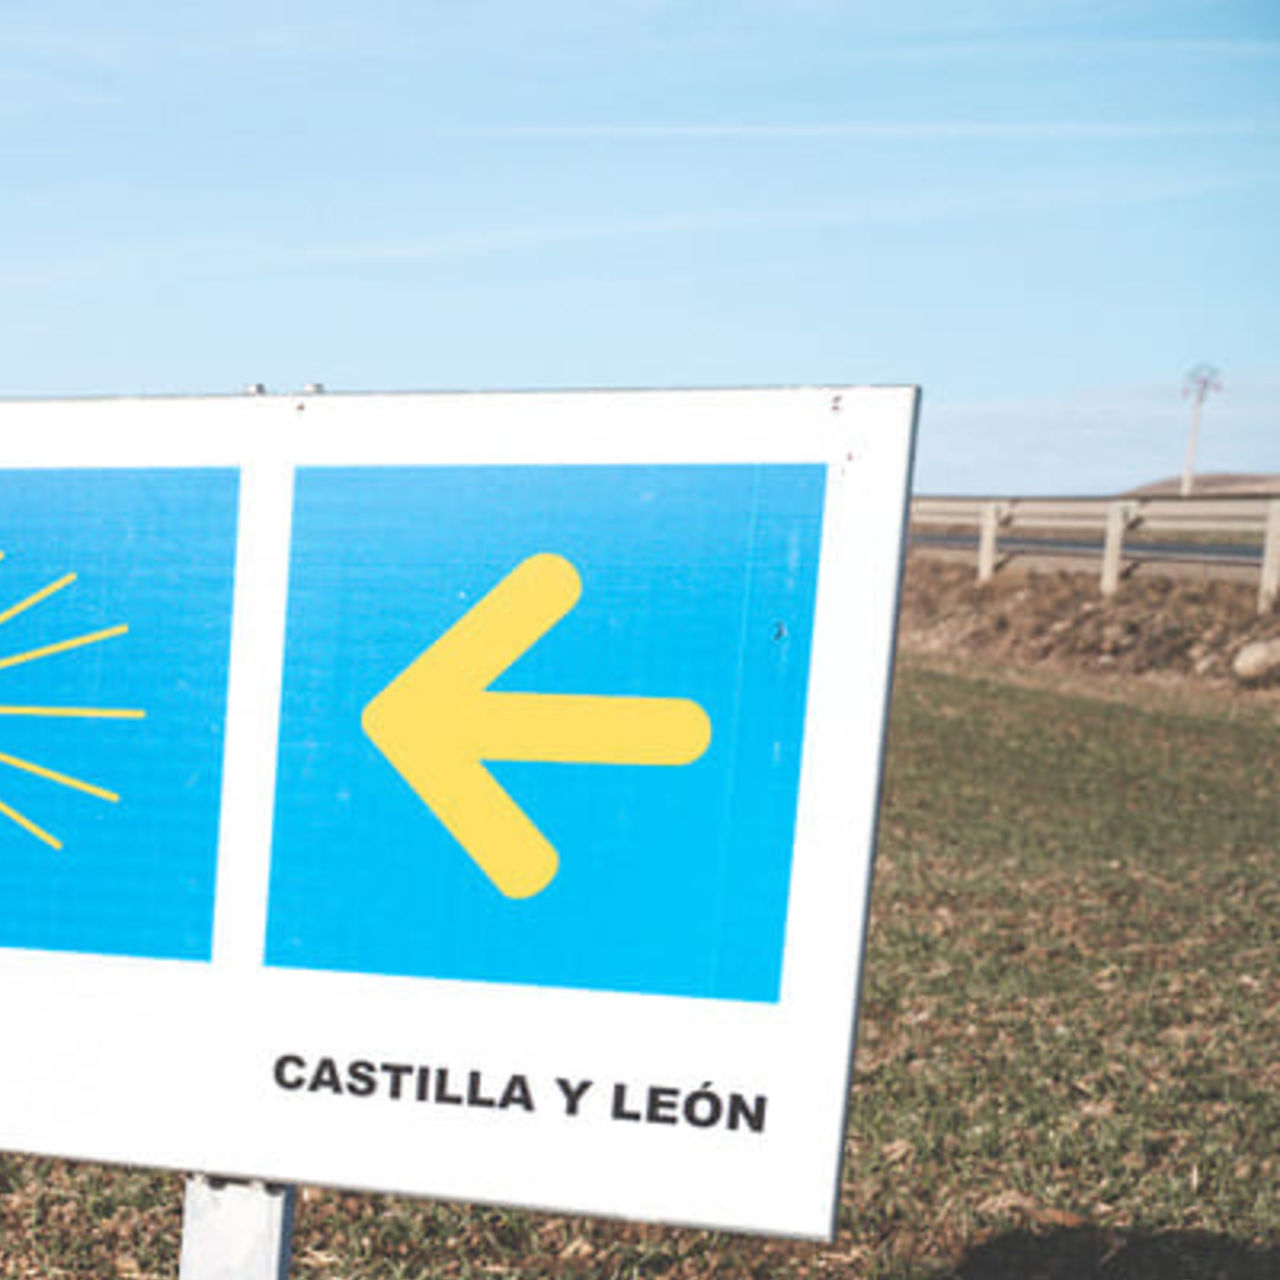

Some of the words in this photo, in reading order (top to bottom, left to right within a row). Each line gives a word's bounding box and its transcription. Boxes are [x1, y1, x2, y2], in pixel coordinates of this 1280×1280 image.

[274, 1055, 534, 1112] CASTILLA
[556, 1078, 593, 1116] Y
[612, 1081, 767, 1133] LEÓN
